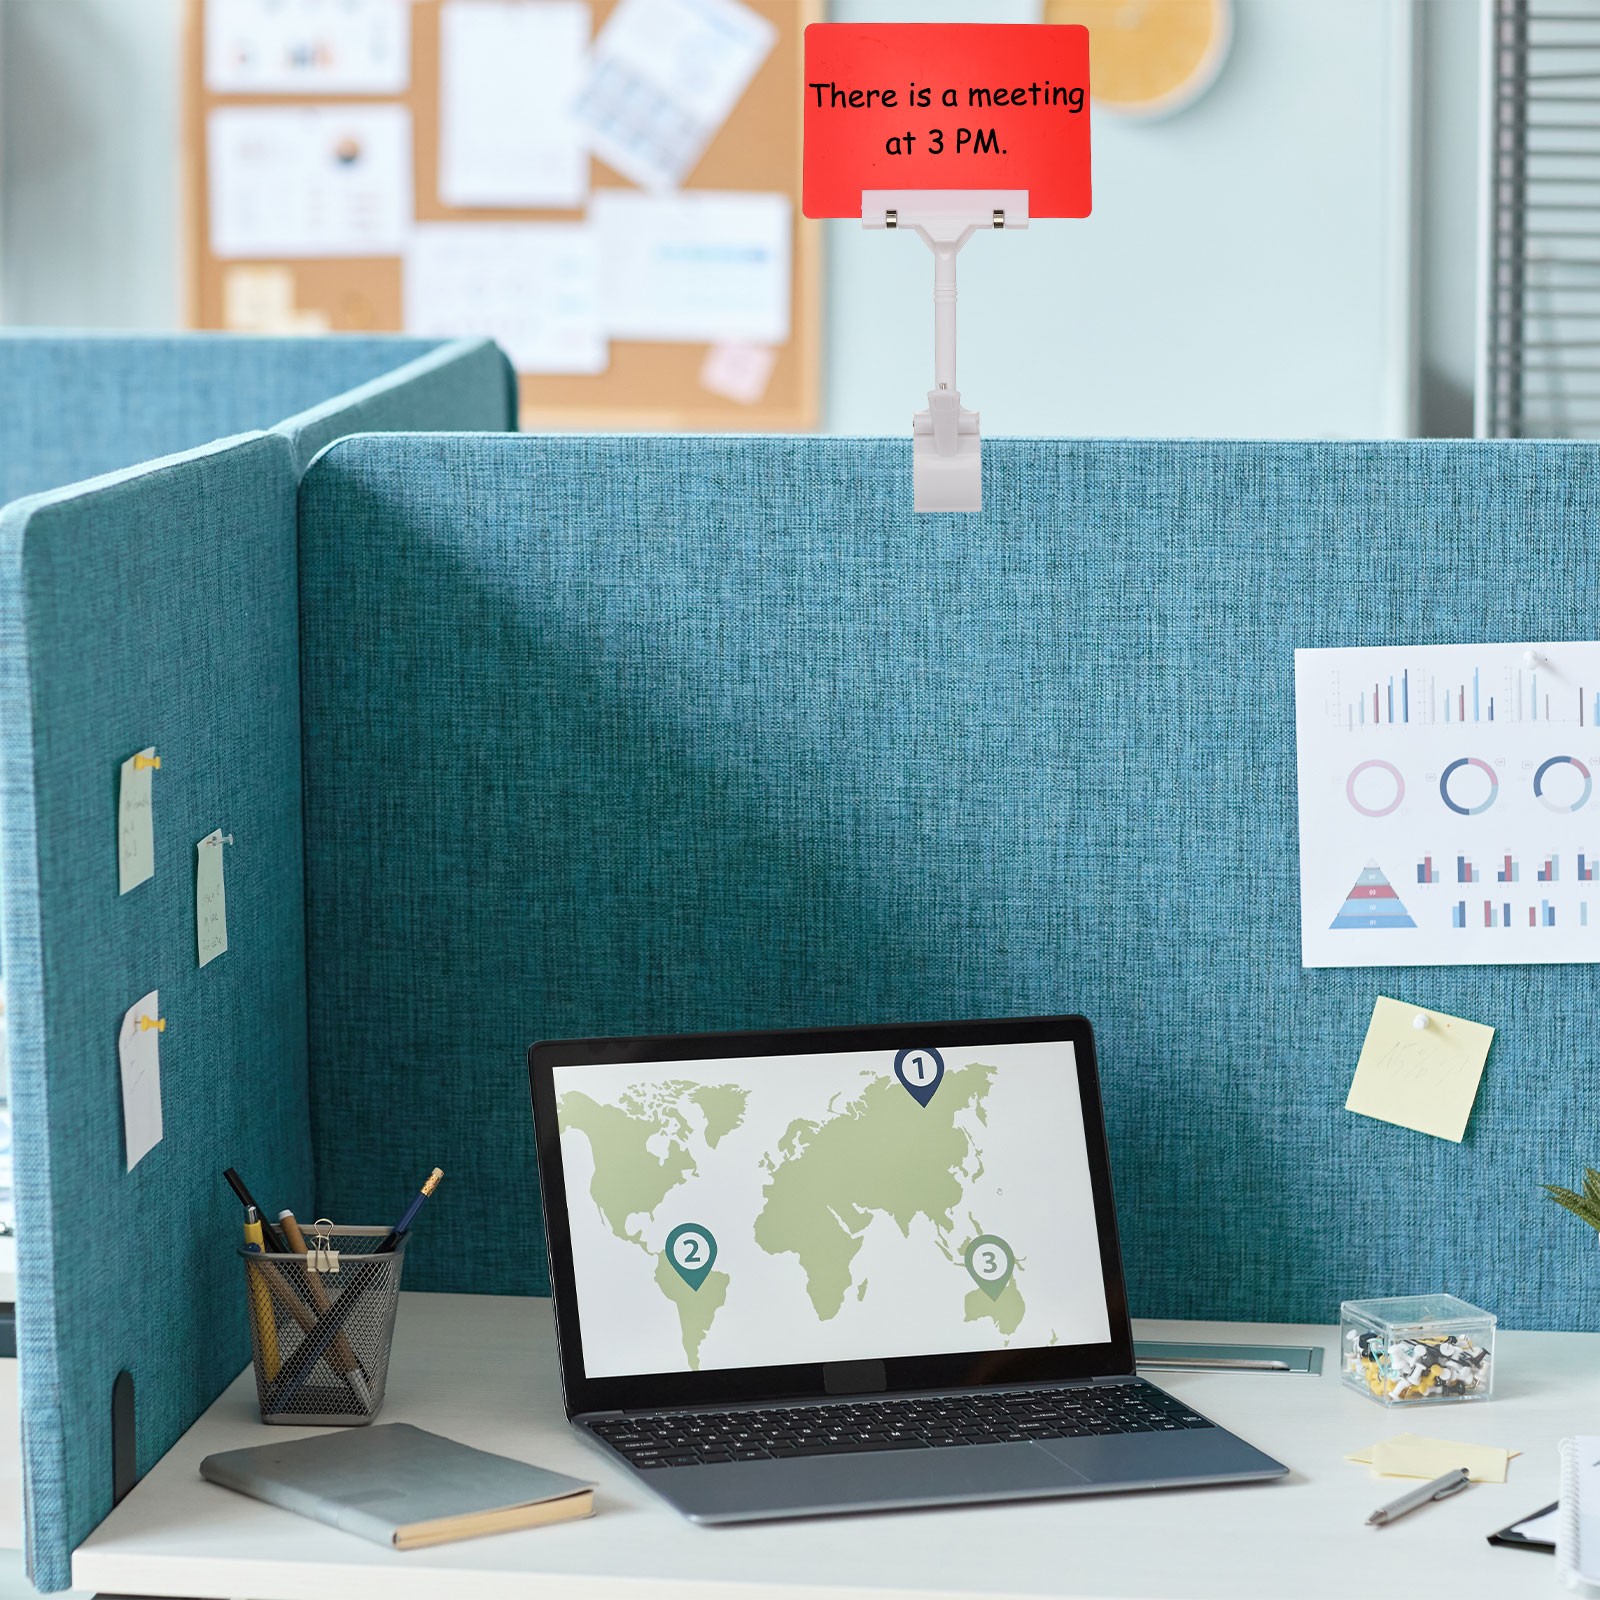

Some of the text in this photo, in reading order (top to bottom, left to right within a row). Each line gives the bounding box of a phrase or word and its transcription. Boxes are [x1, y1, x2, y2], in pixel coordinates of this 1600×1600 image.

[808, 80, 1085, 114] There is a meeting
[885, 127, 1007, 155] at 3 PM.
[911, 1056, 925, 1080] 1
[682, 1238, 701, 1264] 2
[981, 1251, 998, 1274] 3
